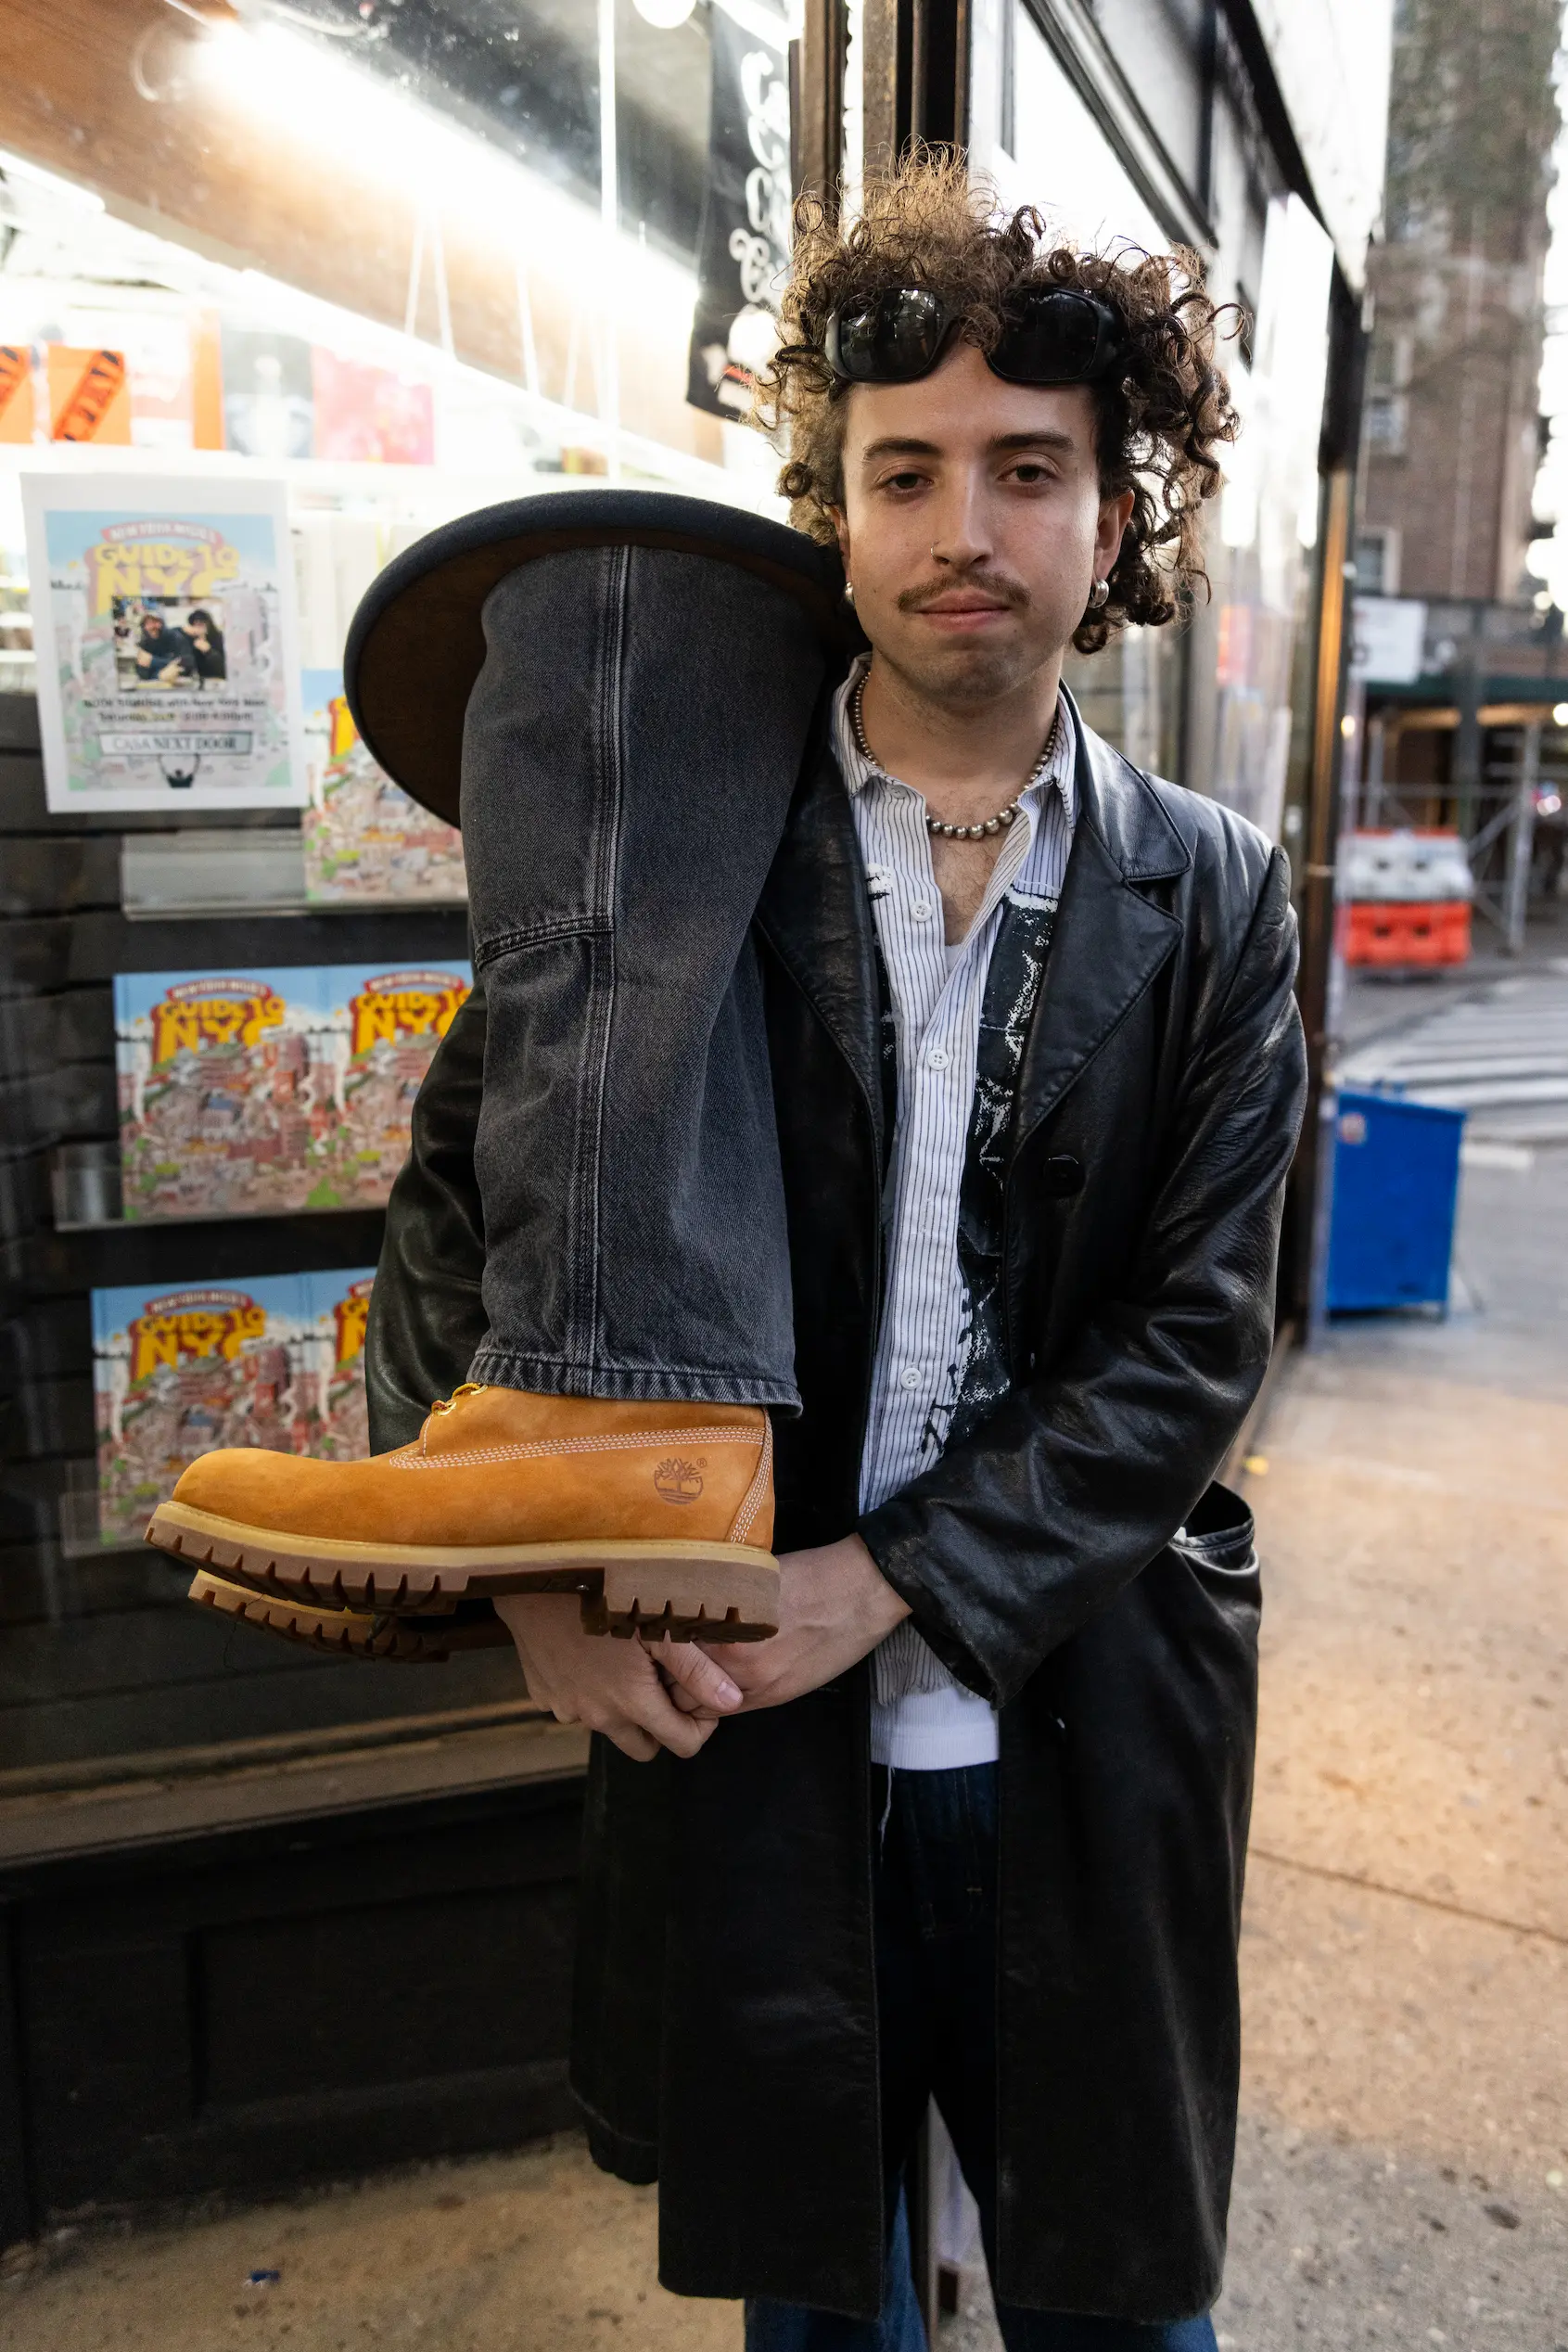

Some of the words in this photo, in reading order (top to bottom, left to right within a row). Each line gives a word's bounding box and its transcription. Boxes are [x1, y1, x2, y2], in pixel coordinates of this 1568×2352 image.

[95, 543, 194, 569] GUIDE
[195, 543, 241, 568] TO
[96, 561, 241, 617] NYC
[153, 736, 191, 750] NEXT
[196, 736, 237, 750] DOOR
[158, 999, 248, 1020] GUIDE
[248, 995, 287, 1021] TO
[159, 1016, 285, 1063] NYC
[138, 1311, 228, 1334] GUIDE
[228, 1306, 267, 1334] TO
[138, 1330, 265, 1380] NYC
